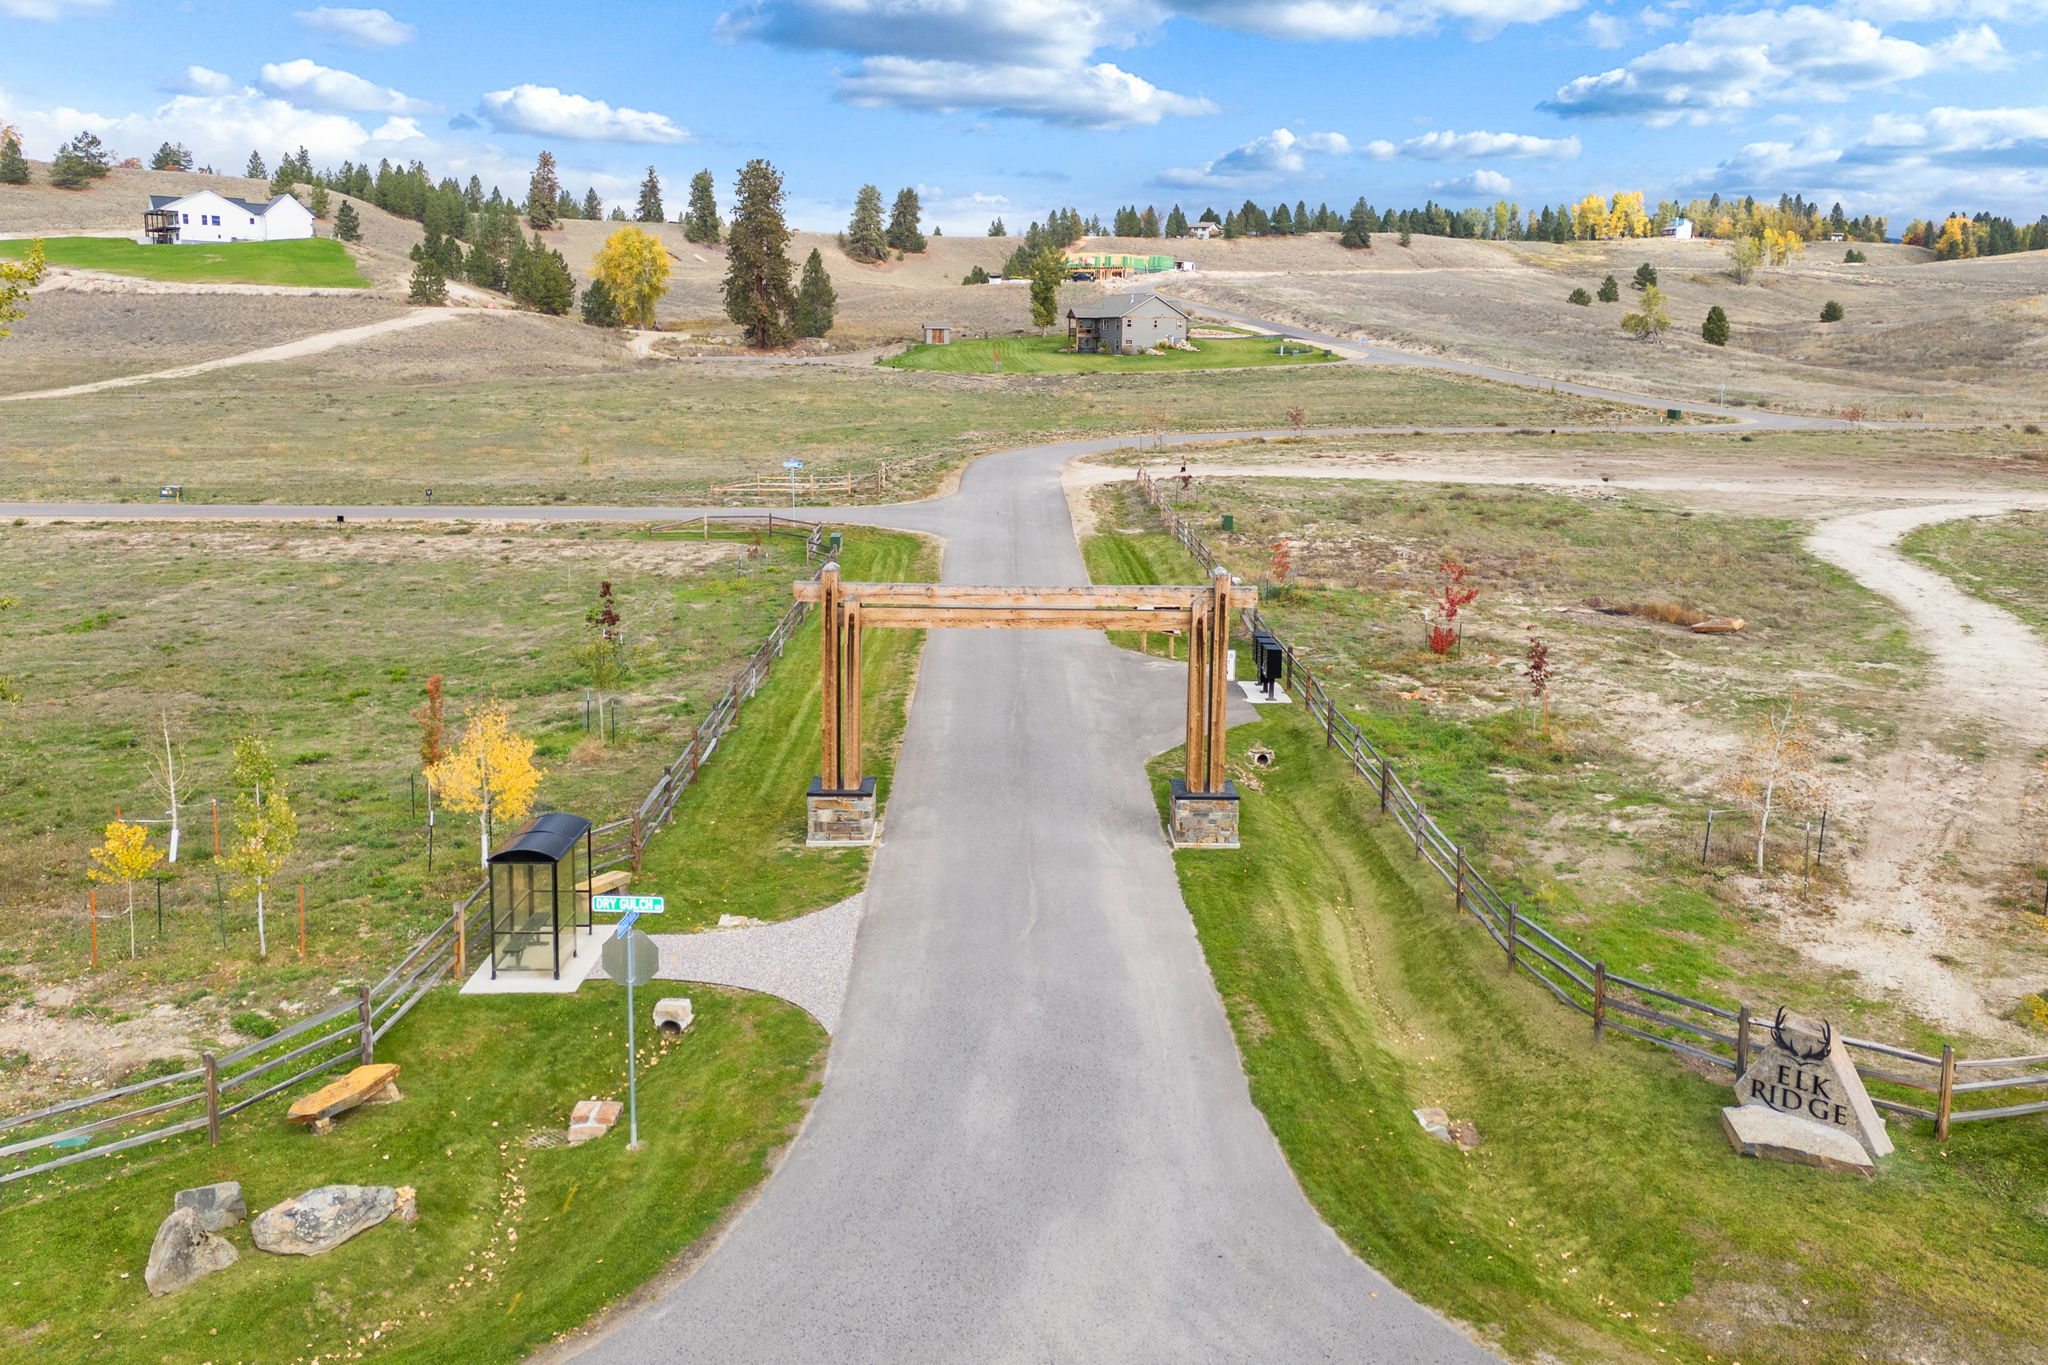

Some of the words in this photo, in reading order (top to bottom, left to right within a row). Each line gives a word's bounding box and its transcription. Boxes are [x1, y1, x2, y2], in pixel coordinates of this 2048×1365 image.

[596, 898, 617, 909] DRY
[619, 898, 653, 910] GULCH
[1778, 1064, 1831, 1099] ELK
[1751, 1079, 1847, 1126] RIDGE
